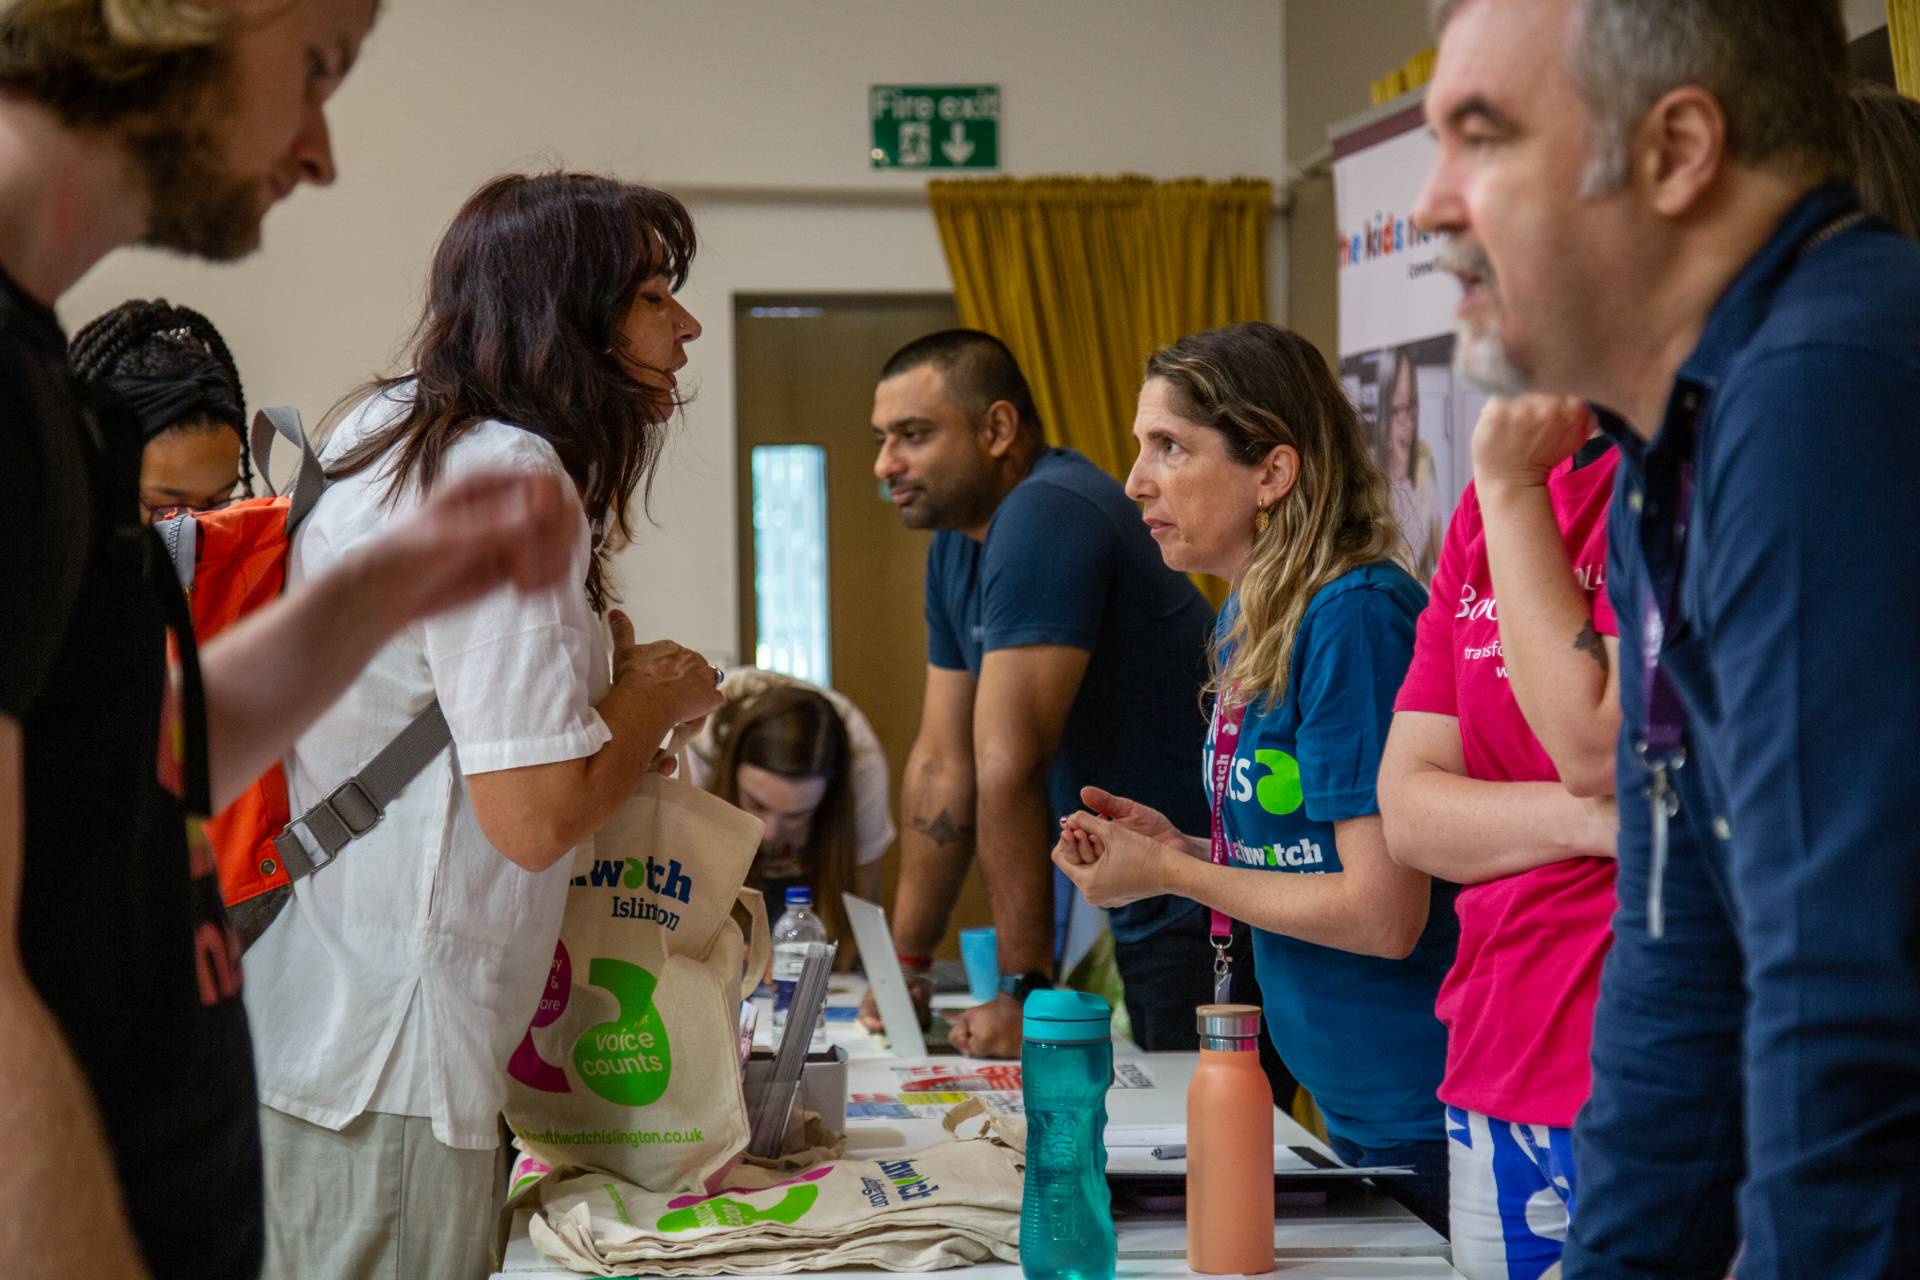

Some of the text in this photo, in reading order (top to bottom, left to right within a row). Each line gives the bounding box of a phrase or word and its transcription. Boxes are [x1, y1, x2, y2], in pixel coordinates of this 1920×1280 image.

[872, 89, 999, 120] Fire exit
[1363, 211, 1404, 260] kids
[595, 1027, 655, 1051] voice
[581, 1052, 664, 1077] counts
